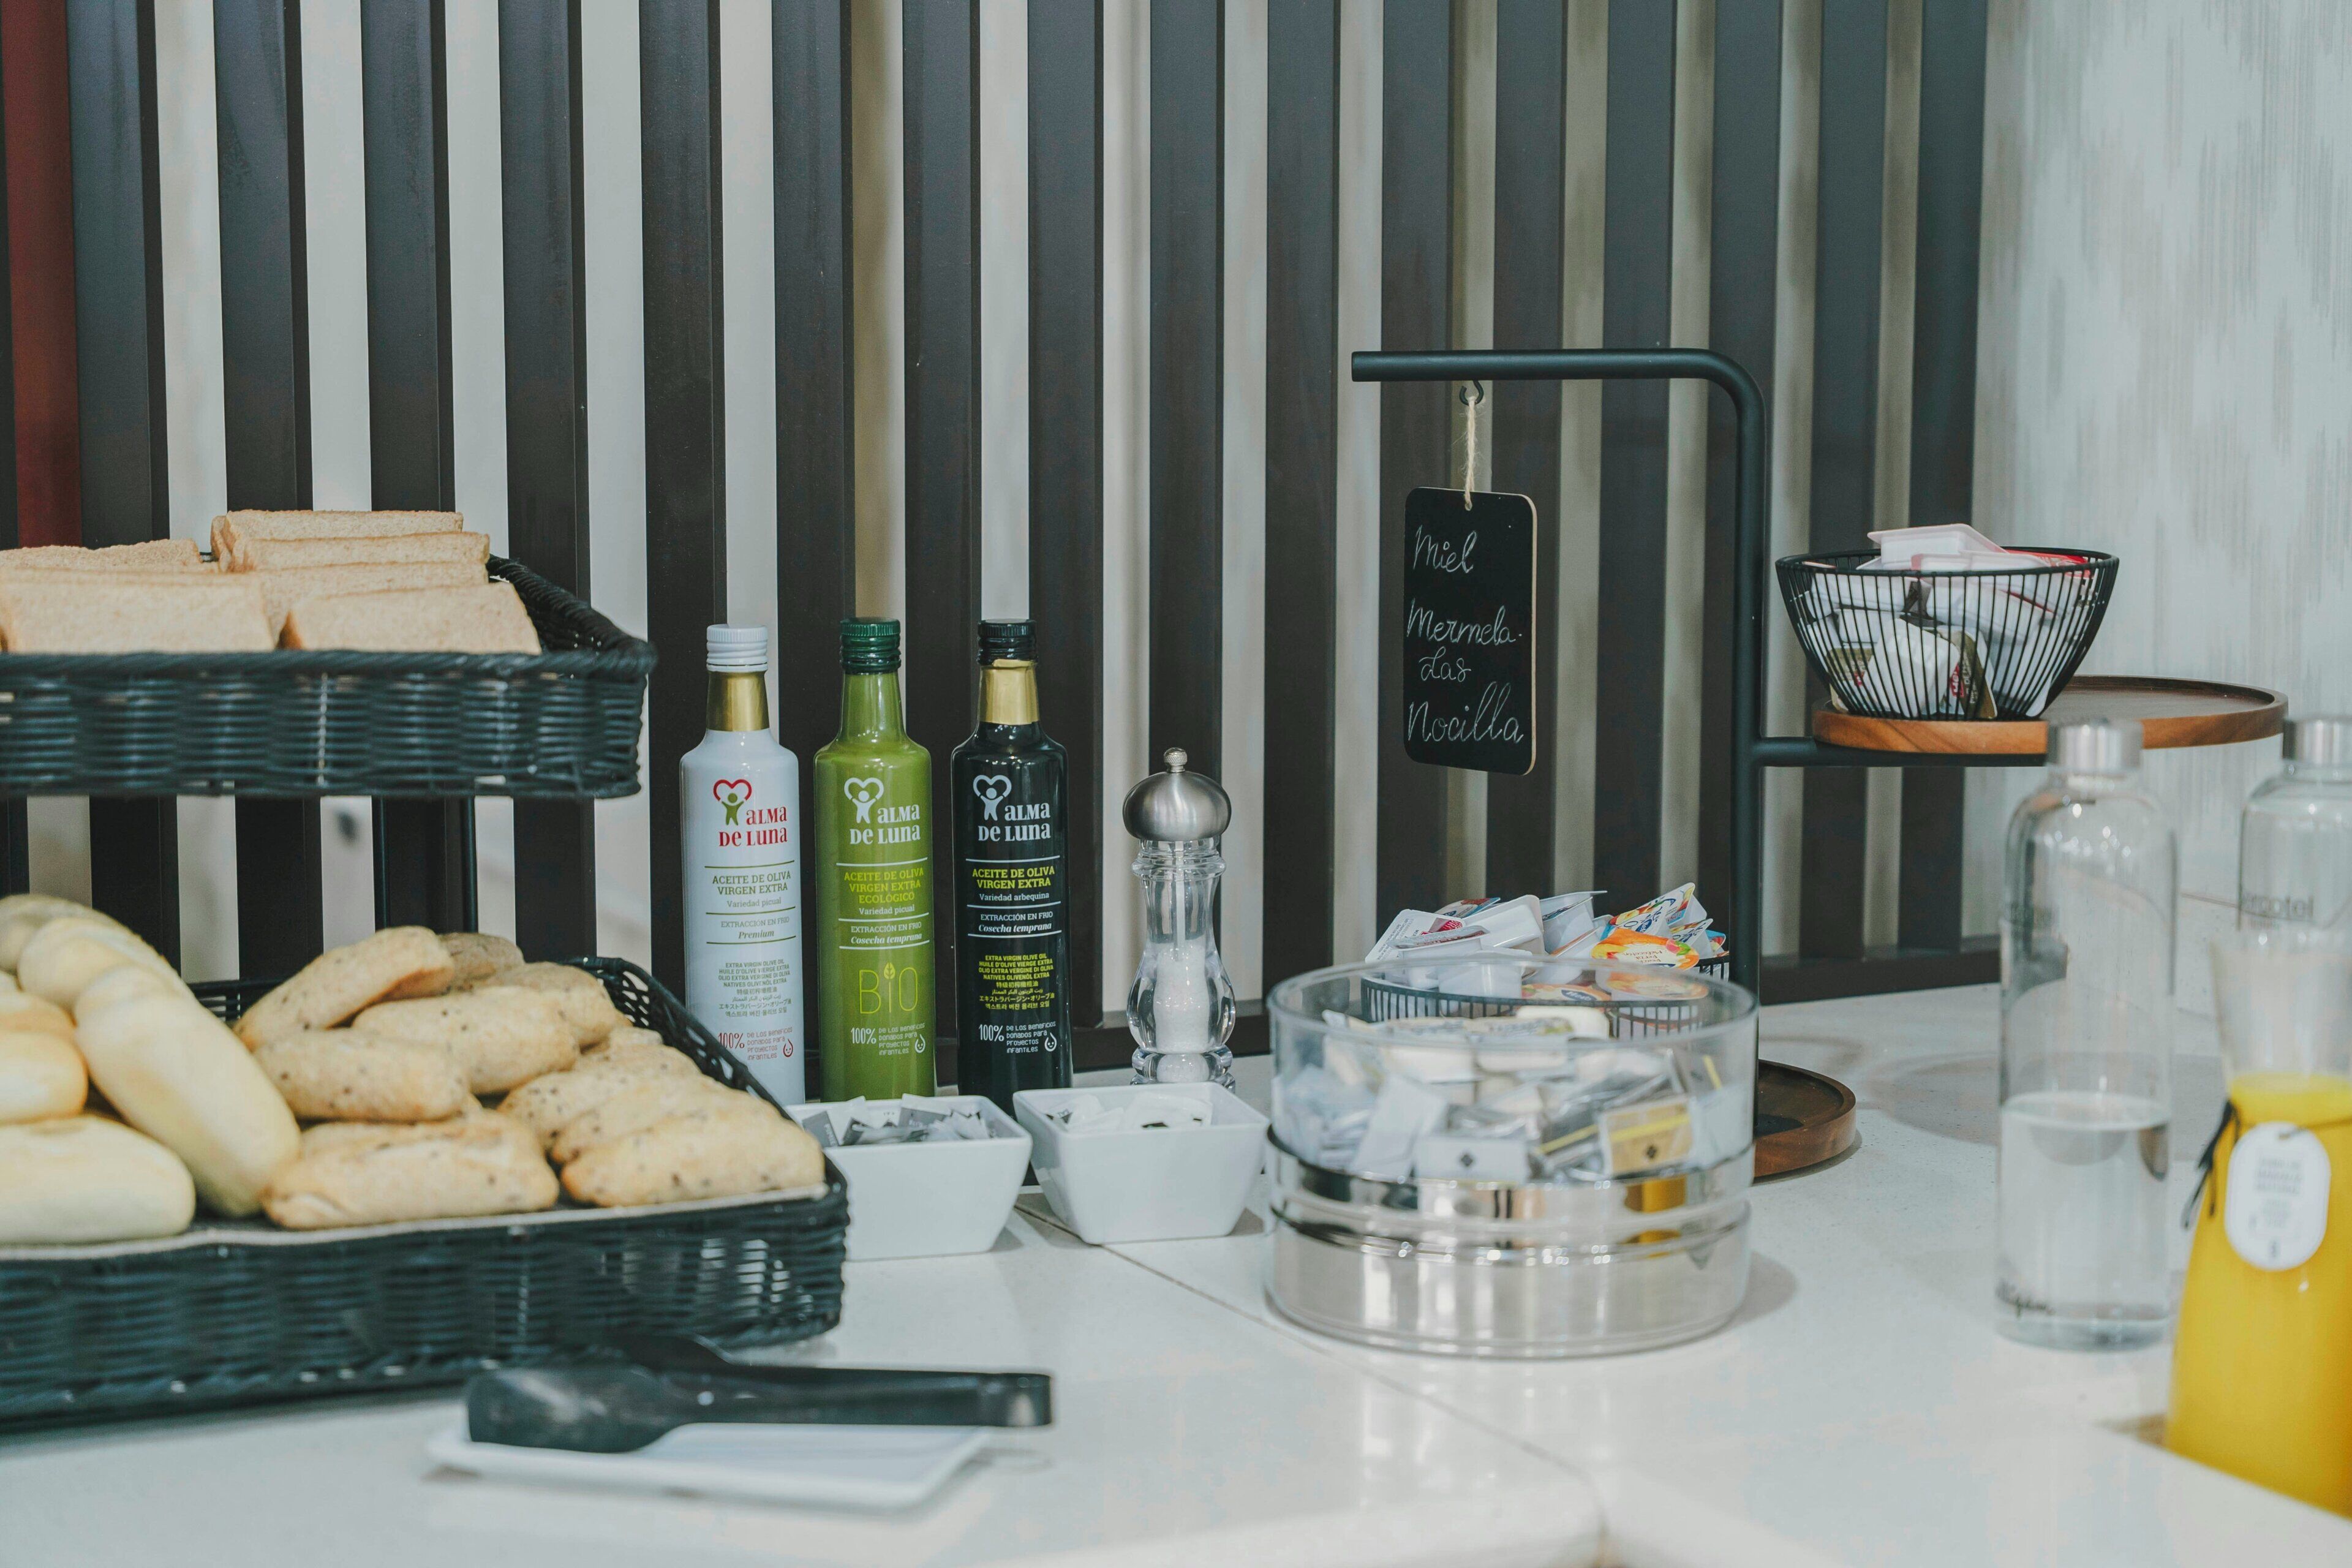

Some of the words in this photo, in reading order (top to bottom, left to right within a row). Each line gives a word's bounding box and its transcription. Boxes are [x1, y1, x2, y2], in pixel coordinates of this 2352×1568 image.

[1413, 524, 1477, 573] Miel
[1408, 681, 1525, 744] Nocilla
[712, 875, 748, 884] ACEITE
[752, 875, 764, 883] DE
[767, 871, 791, 882] OLIVA
[844, 872, 882, 881] ACEITE
[884, 871, 897, 881] DE
[899, 867, 924, 879] OLIVA
[972, 869, 1008, 878] ACEITE
[1011, 869, 1025, 878] DE
[1027, 865, 1055, 877] OLIVA
[718, 886, 756, 895] VIRGEN
[759, 883, 788, 894] EXTRA
[849, 883, 888, 892] VIRGEN
[891, 880, 921, 891] EXTRA
[977, 880, 1016, 889] VIRGEN
[1018, 877, 1051, 889] EXTRA
[726, 899, 760, 908] Variedad
[762, 897, 782, 907] picual
[859, 892, 914, 903] ECOLÓGICO
[1014, 892, 1049, 902] arbequina
[894, 904, 915, 916] picual
[981, 913, 1026, 921] EXTRACCIÓN
[721, 919, 766, 928] EXTRACCIÓN
[851, 924, 897, 933] EXTRACCIÓN
[979, 924, 1011, 933] Cosecha
[1013, 923, 1052, 933] temprana
[738, 930, 774, 939] Premium
[851, 935, 884, 944] Cosecha
[887, 933, 922, 944] temprana
[851, 1027, 876, 1044] 100%
[979, 1024, 1005, 1041] 100%
[718, 1032, 745, 1049] 100%
